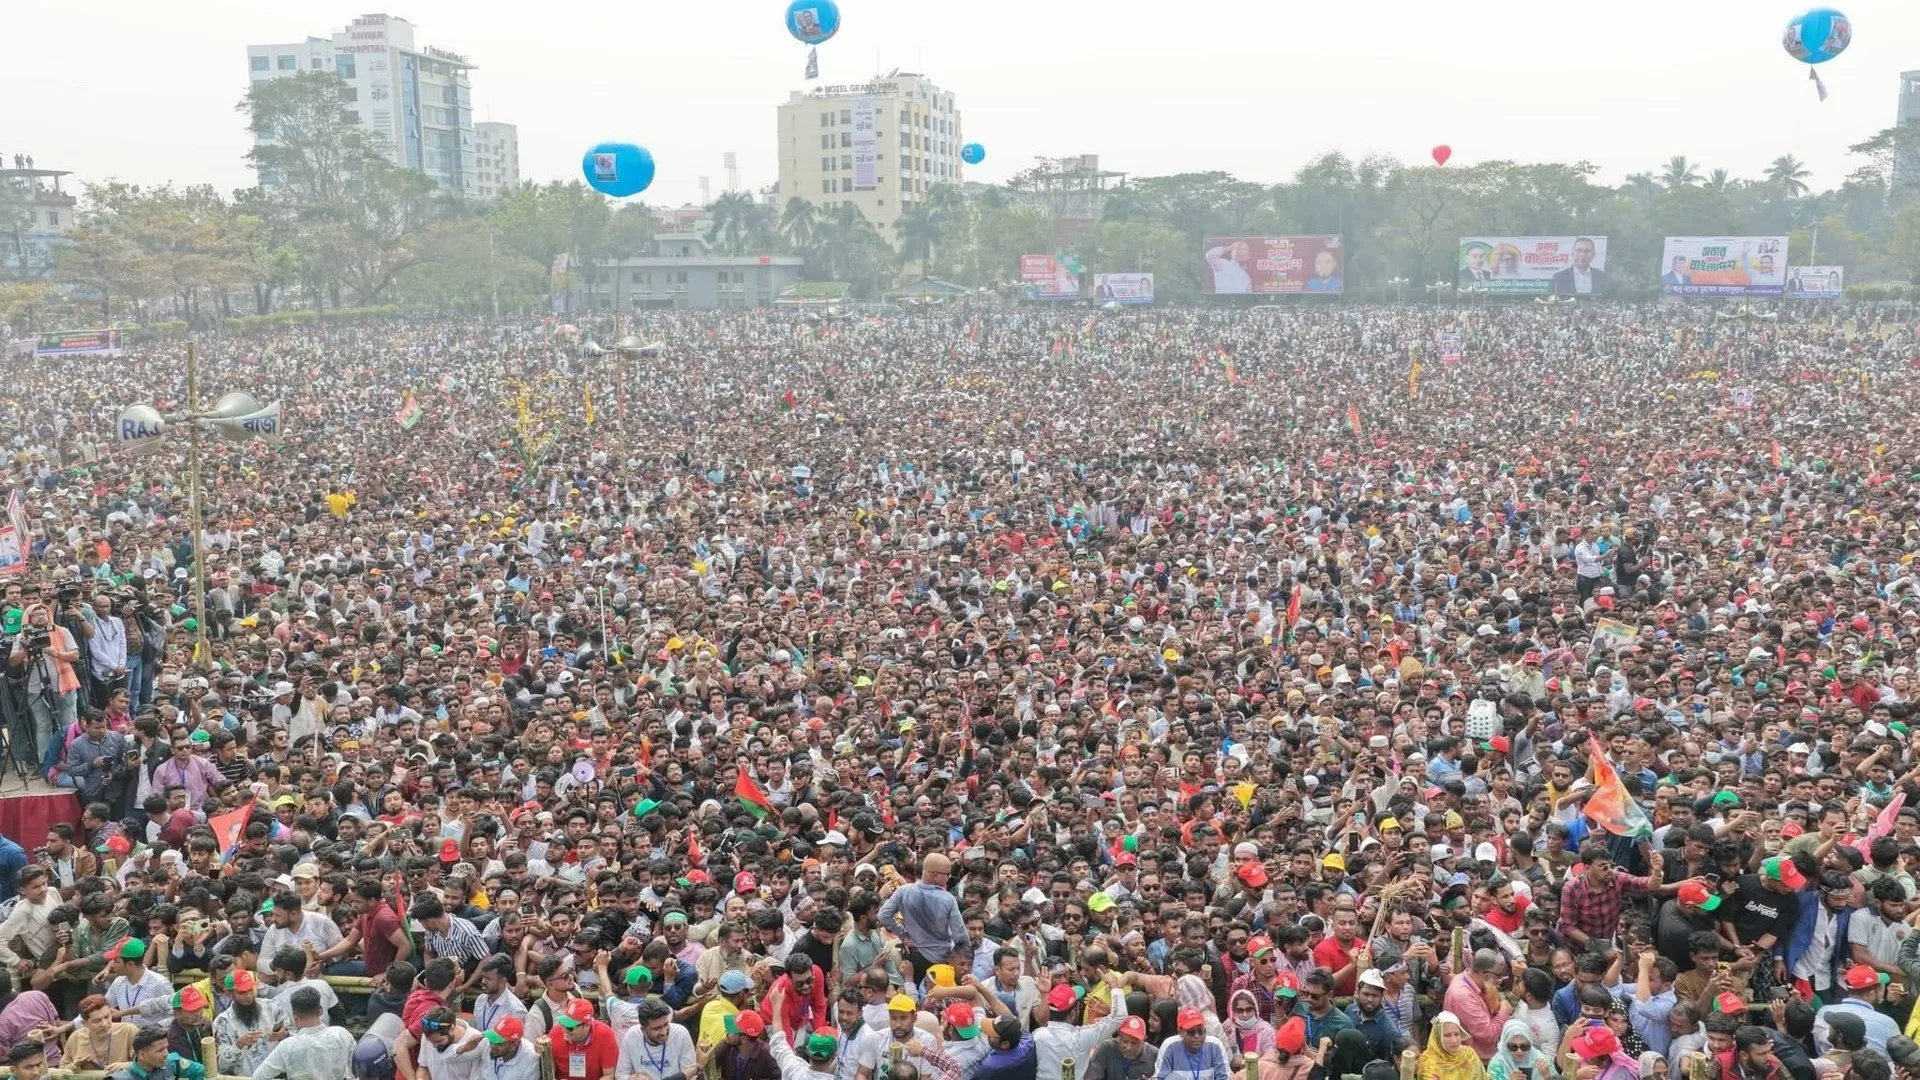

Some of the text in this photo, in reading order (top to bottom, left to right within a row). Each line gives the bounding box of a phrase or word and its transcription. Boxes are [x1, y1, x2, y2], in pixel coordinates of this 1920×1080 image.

[343, 45, 386, 53] HOSPITAL
[825, 85, 848, 93] HOTEL
[850, 84, 877, 92] GRAND
[1702, 246, 1727, 257] সবার
[1689, 259, 1736, 272] বাংলাদেশ
[122, 419, 159, 440] RAJ
[243, 414, 277, 434] রাজ
